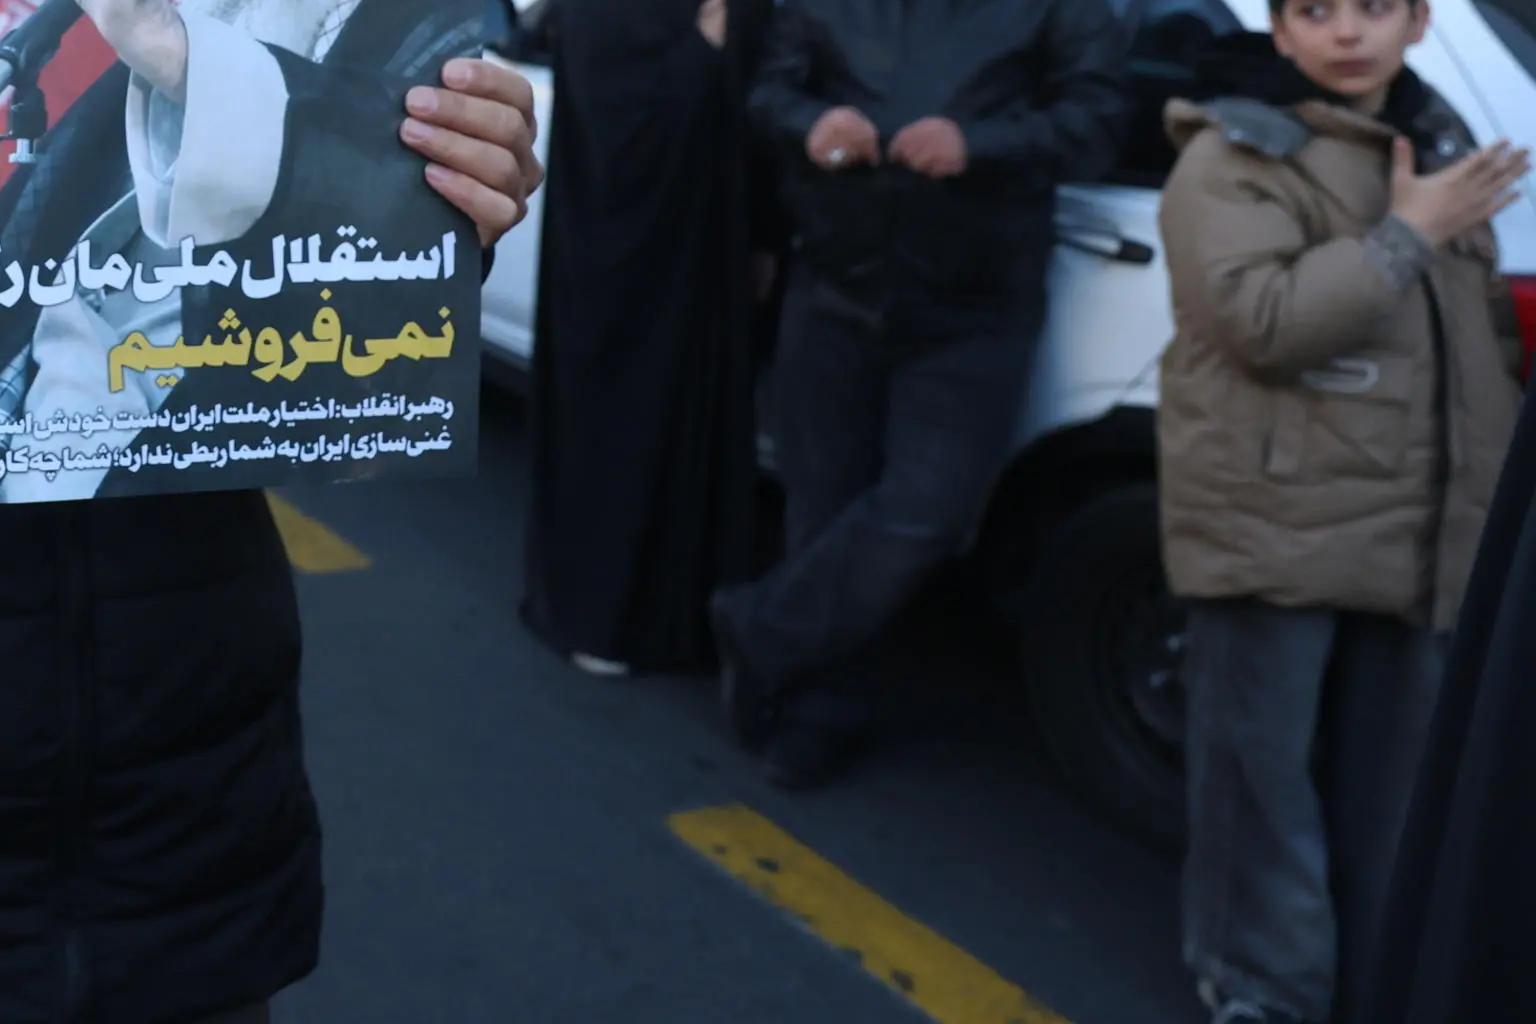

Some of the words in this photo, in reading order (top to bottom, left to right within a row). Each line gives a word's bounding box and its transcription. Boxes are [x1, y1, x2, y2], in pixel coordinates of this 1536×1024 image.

[241, 225, 456, 299] استقلال
[112, 408, 170, 430] دست
[171, 403, 221, 432] ایران
[222, 401, 270, 423] ملت
[269, 397, 335, 427] اختیار
[335, 393, 405, 424] انقلاب:
[404, 395, 454, 421] رهبر
[33, 405, 112, 441] خودش
[62, 443, 113, 470] شما
[113, 443, 173, 472] ندارد؛
[173, 441, 228, 469] ربطی
[228, 435, 276, 460] شما
[276, 438, 300, 464] به
[300, 433, 350, 462] ایران
